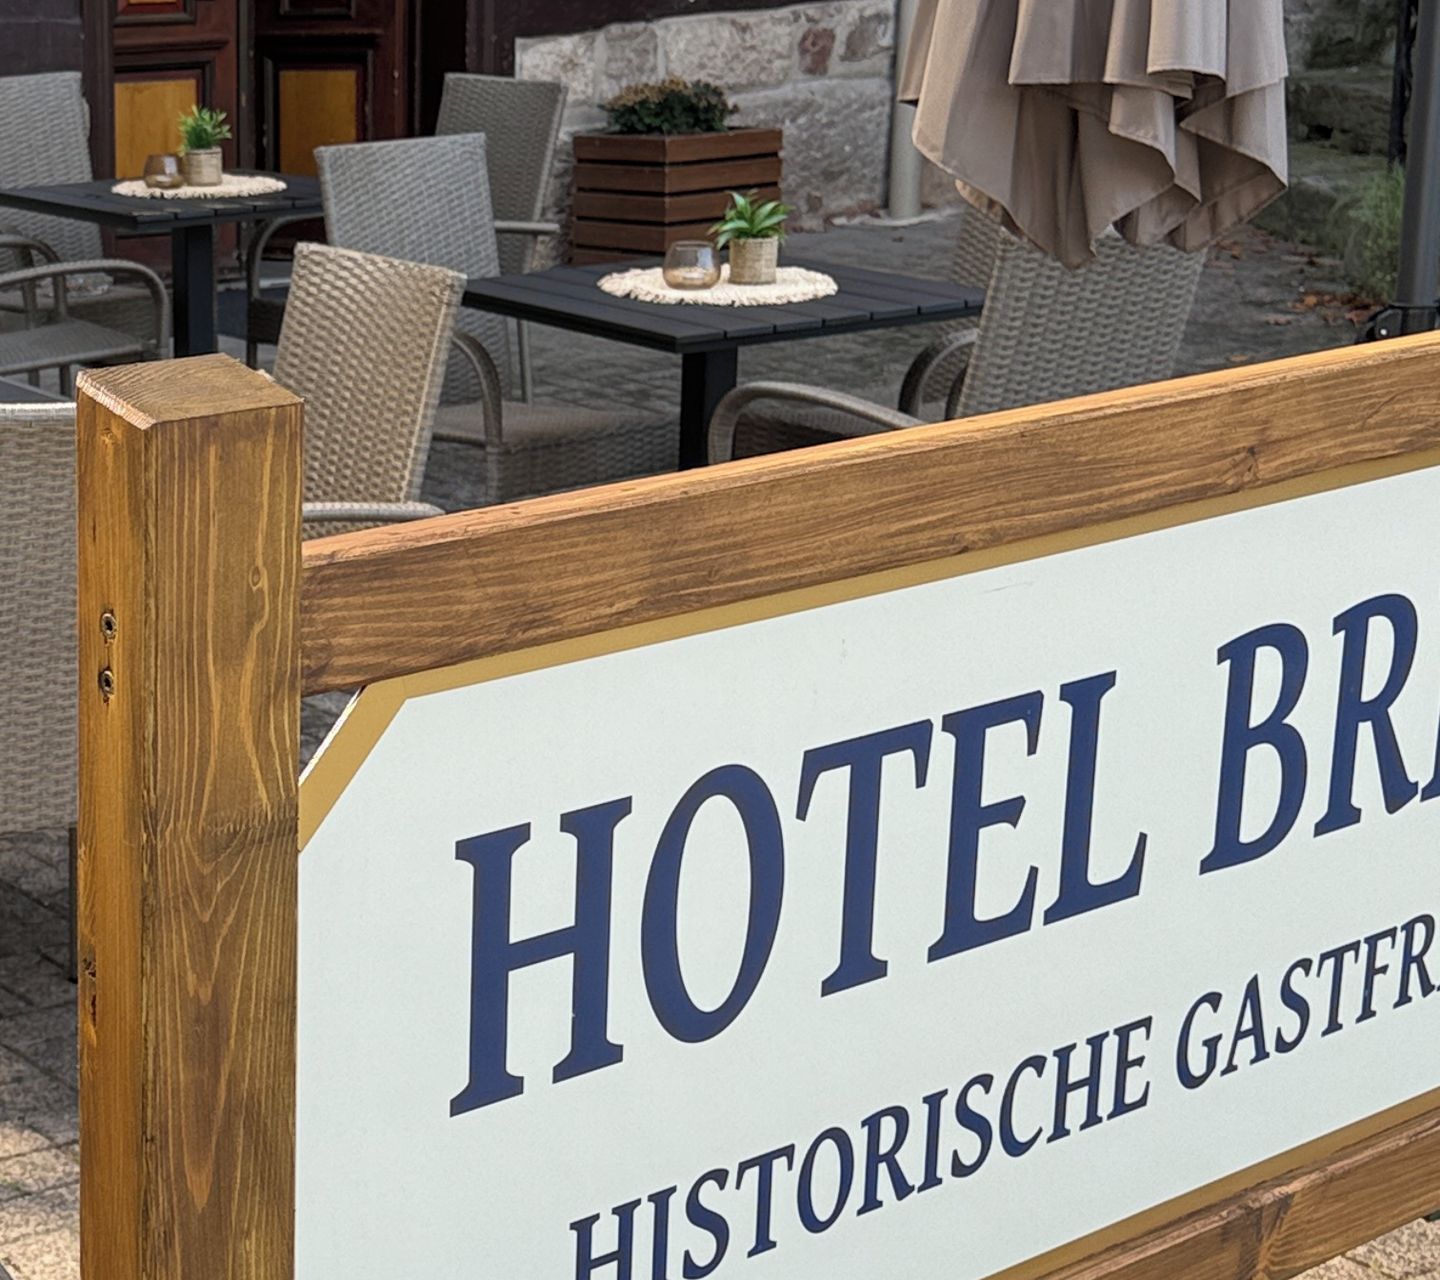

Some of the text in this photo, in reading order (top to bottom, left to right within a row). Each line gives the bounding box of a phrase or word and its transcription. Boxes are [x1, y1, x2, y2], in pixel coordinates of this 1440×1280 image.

[449, 593, 1440, 1118] HOTEL BR
[1176, 914, 1440, 1090] GASTFR
